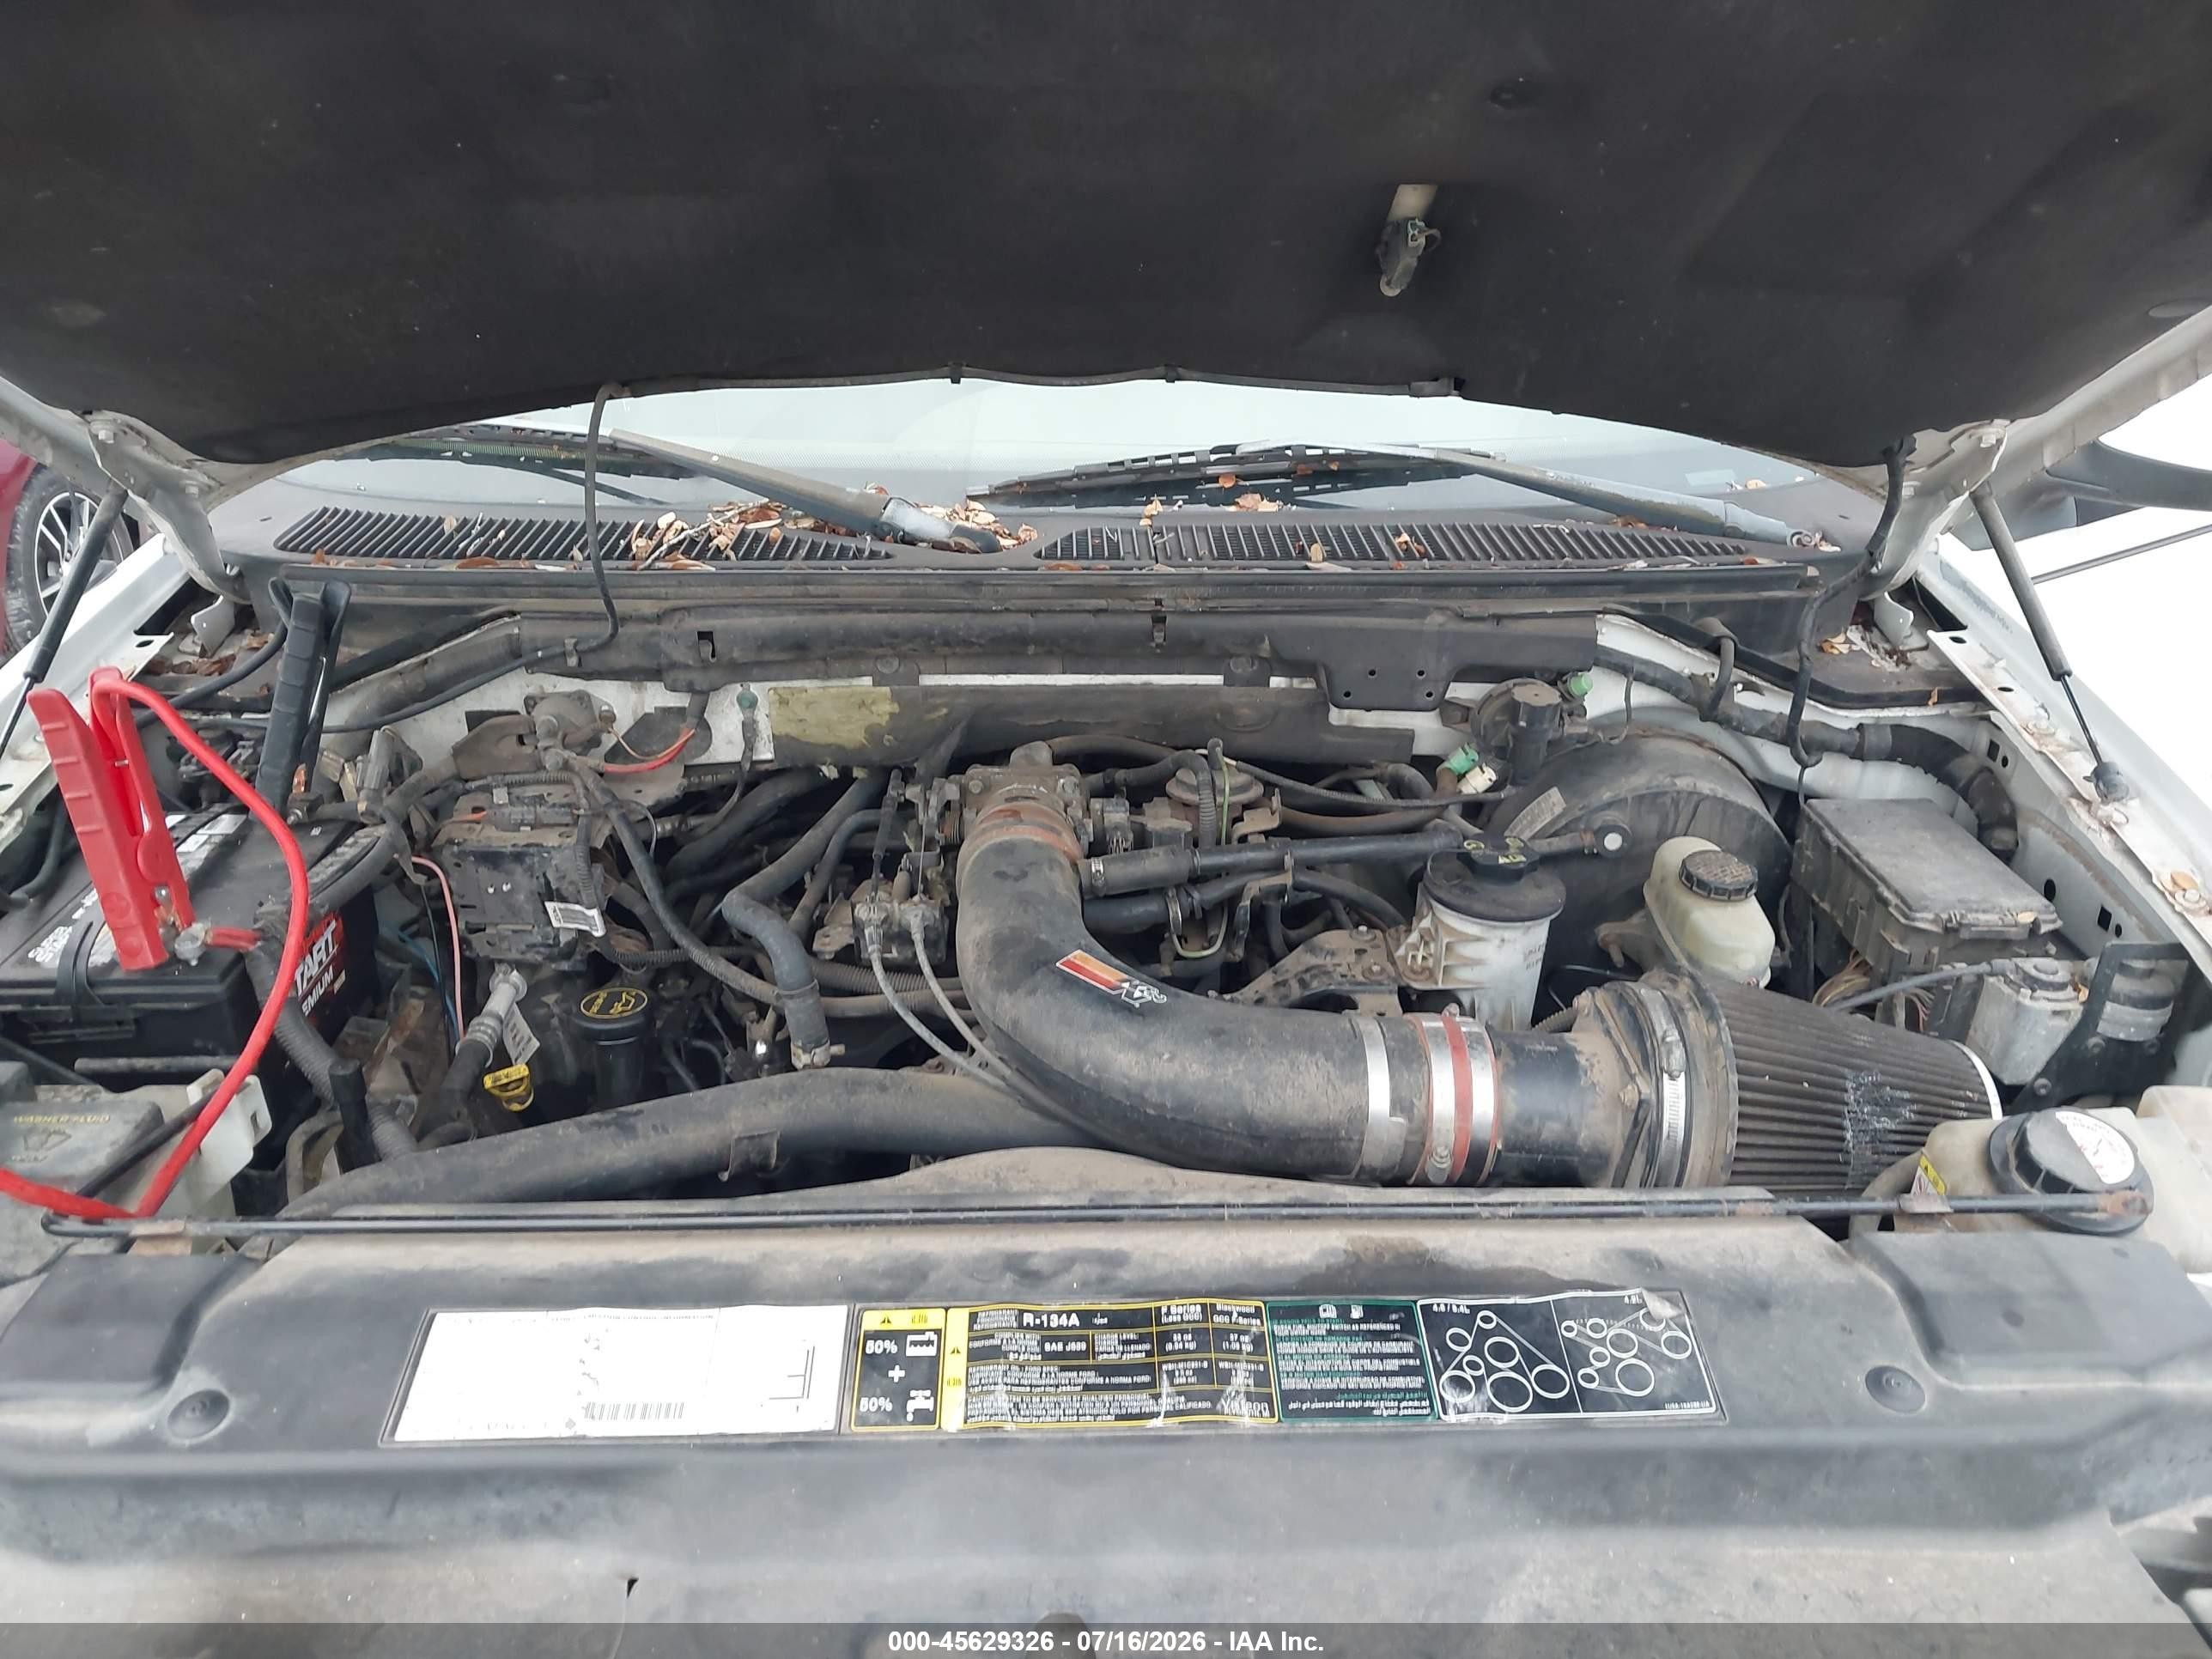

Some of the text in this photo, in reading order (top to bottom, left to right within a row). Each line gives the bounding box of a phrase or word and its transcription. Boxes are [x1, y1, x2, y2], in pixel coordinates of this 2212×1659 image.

[295, 919, 337, 996] TART
[301, 964, 333, 1017] EMIUM
[1023, 1312, 1080, 1328] R-134A
[866, 1340, 897, 1354] 50%
[860, 1396, 892, 1412] 50%
